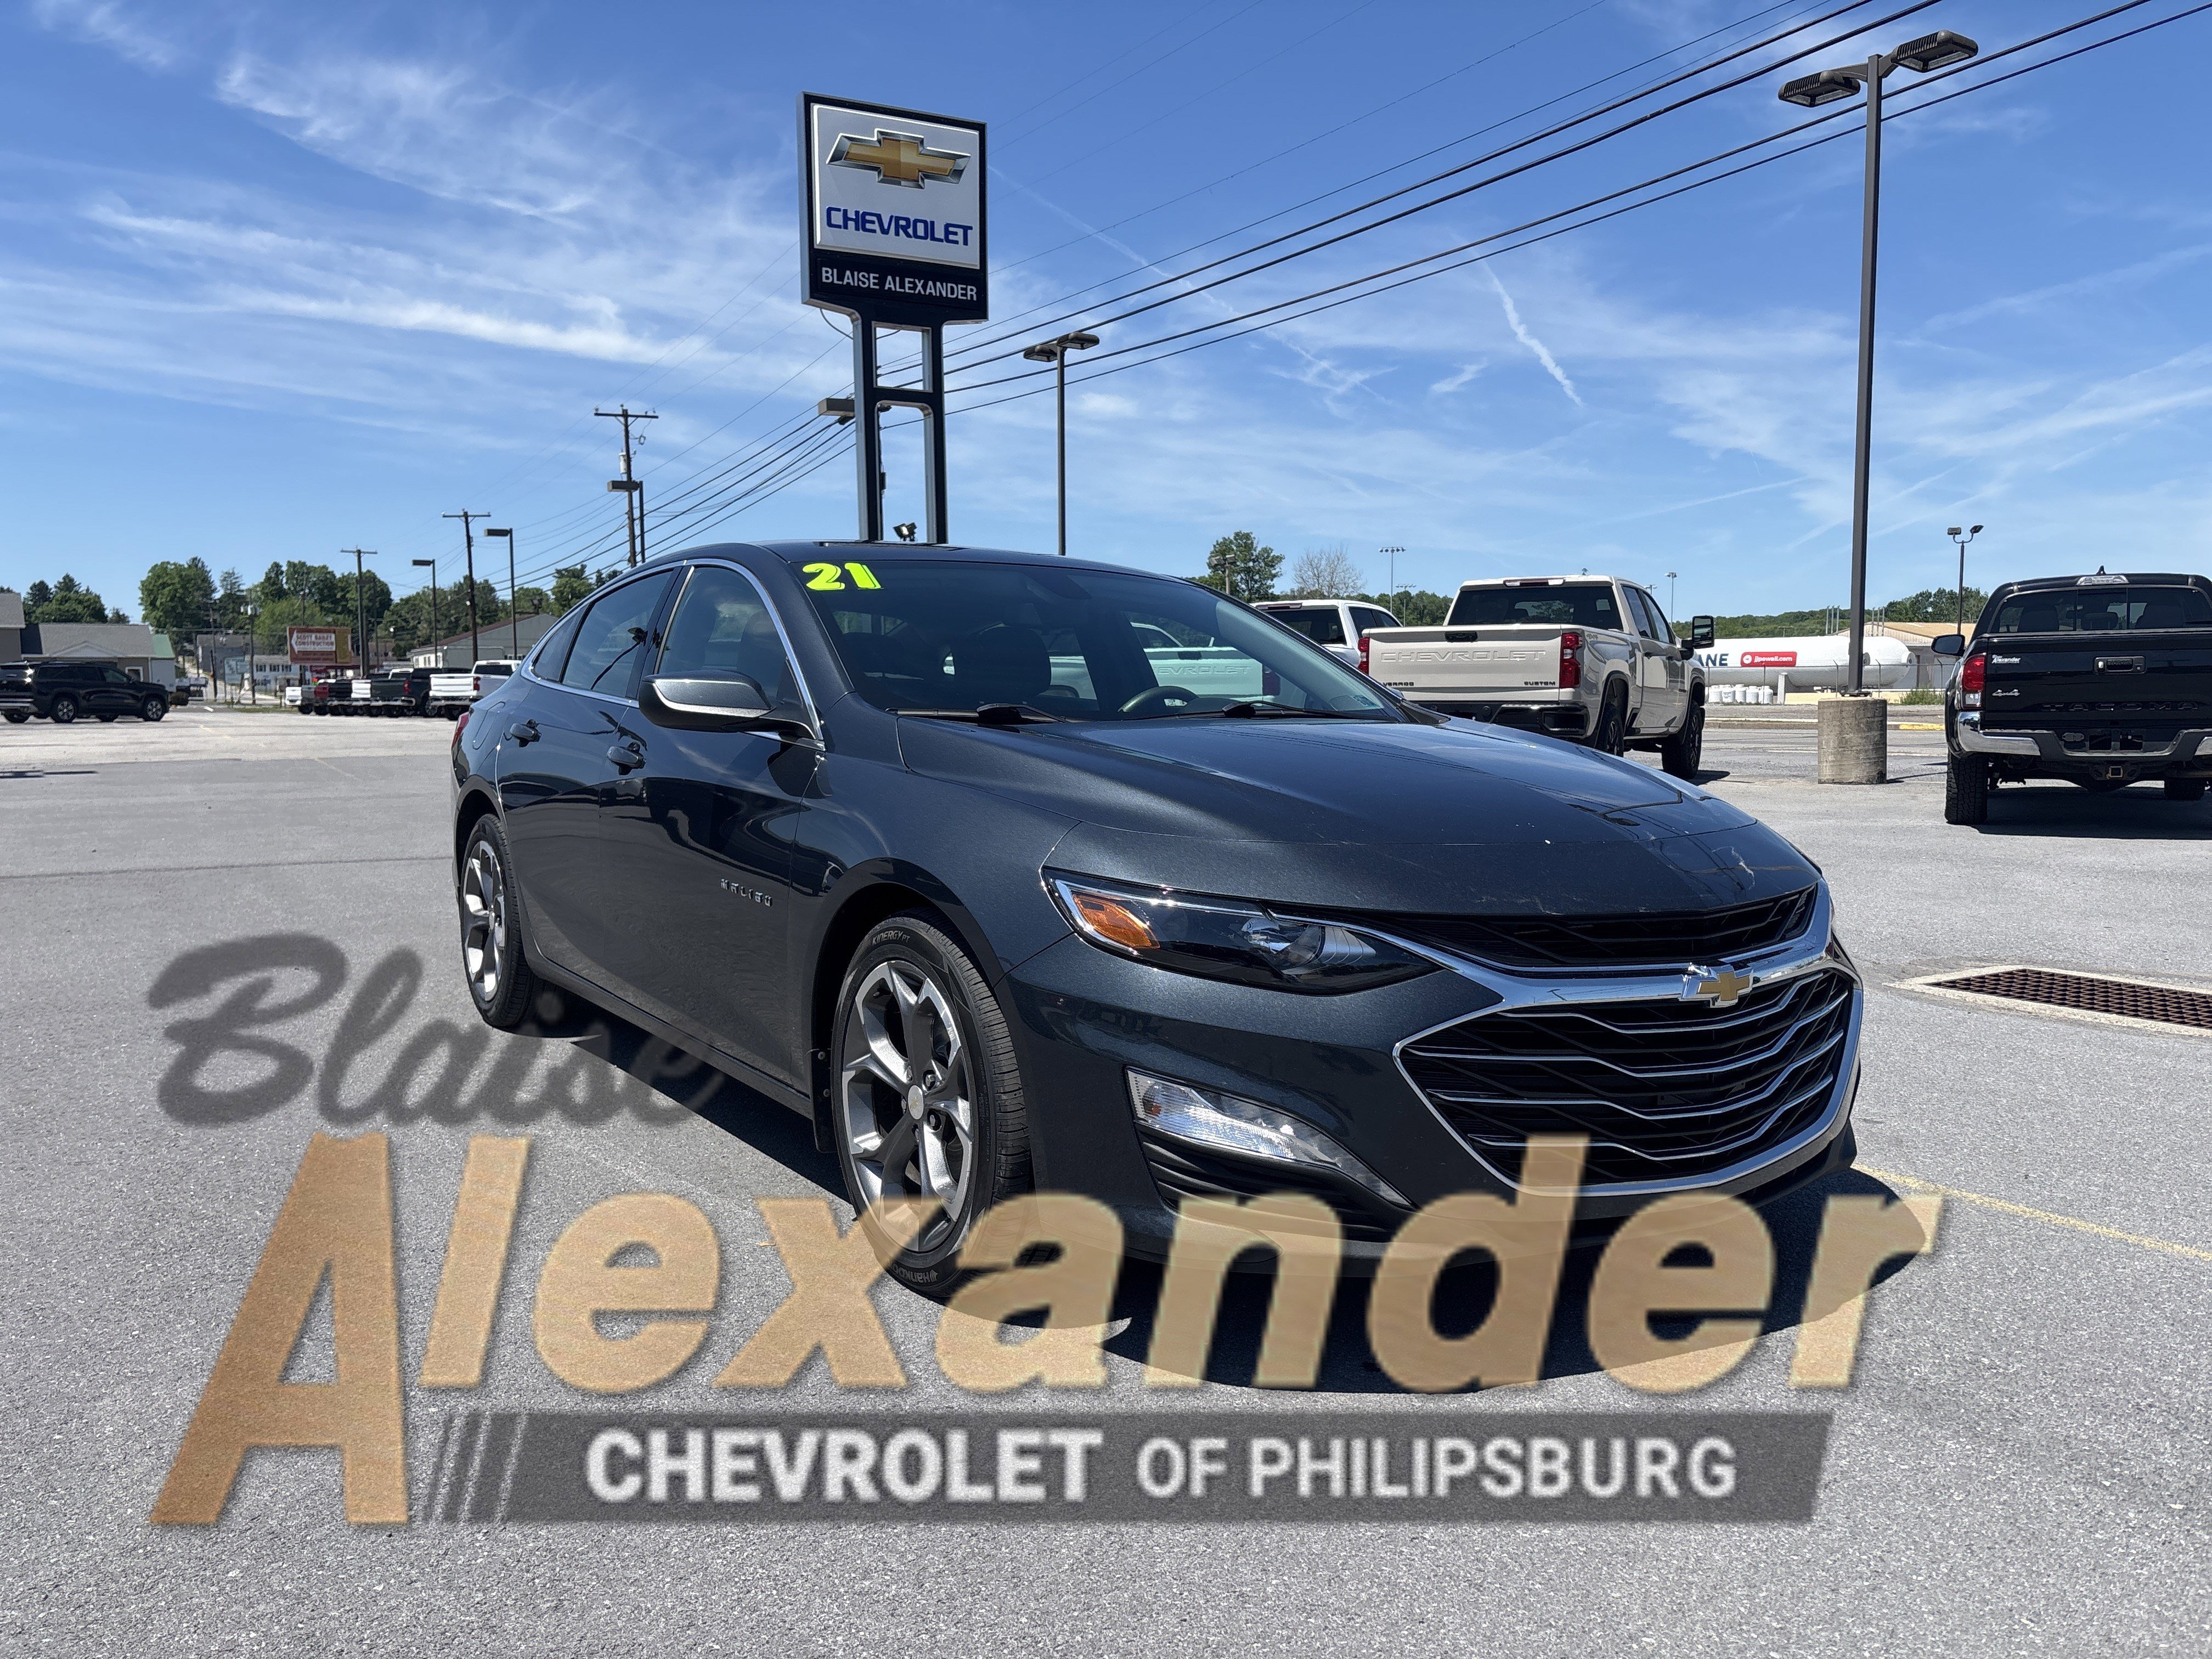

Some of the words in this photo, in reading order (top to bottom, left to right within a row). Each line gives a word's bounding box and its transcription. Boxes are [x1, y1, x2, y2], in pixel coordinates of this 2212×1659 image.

[826, 206, 973, 246] CHEVROLET
[822, 267, 879, 289] BLAISE
[884, 275, 977, 301] ALEXANDER
[803, 562, 882, 590] 21
[1381, 650, 1547, 662] CHEVROLET
[2042, 703, 2198, 711] TACOMA
[721, 879, 772, 907] MALIBU
